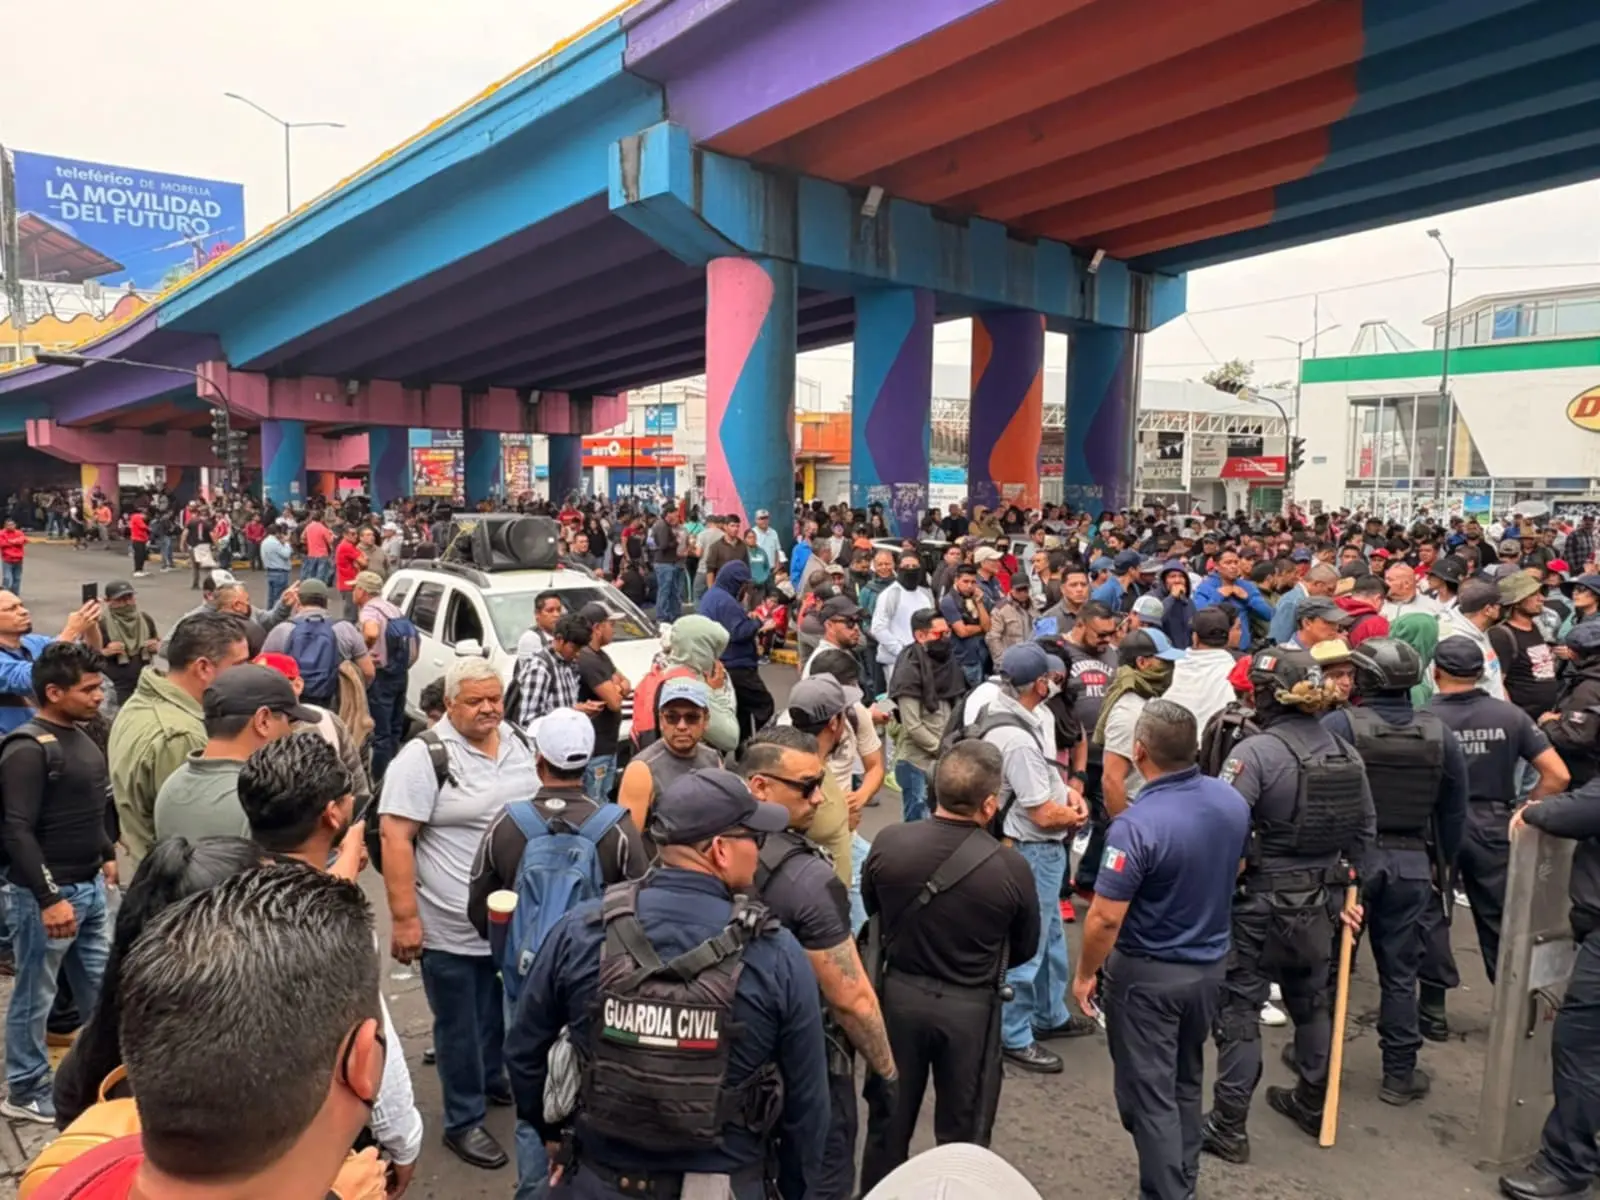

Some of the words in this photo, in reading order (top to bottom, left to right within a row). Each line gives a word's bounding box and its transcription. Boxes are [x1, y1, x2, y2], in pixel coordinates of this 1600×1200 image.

[56, 165, 134, 186] teleférico
[140, 178, 155, 190] DE
[161, 182, 211, 196] MORELIA
[46, 180, 78, 201] LA
[84, 185, 221, 218] MOVILIDAD
[61, 201, 109, 224] DEL
[113, 207, 210, 234] FUTURO
[1452, 728, 1506, 741] ARDIA
[604, 998, 672, 1036] GUARDIA
[677, 1009, 719, 1039] CIVIL
